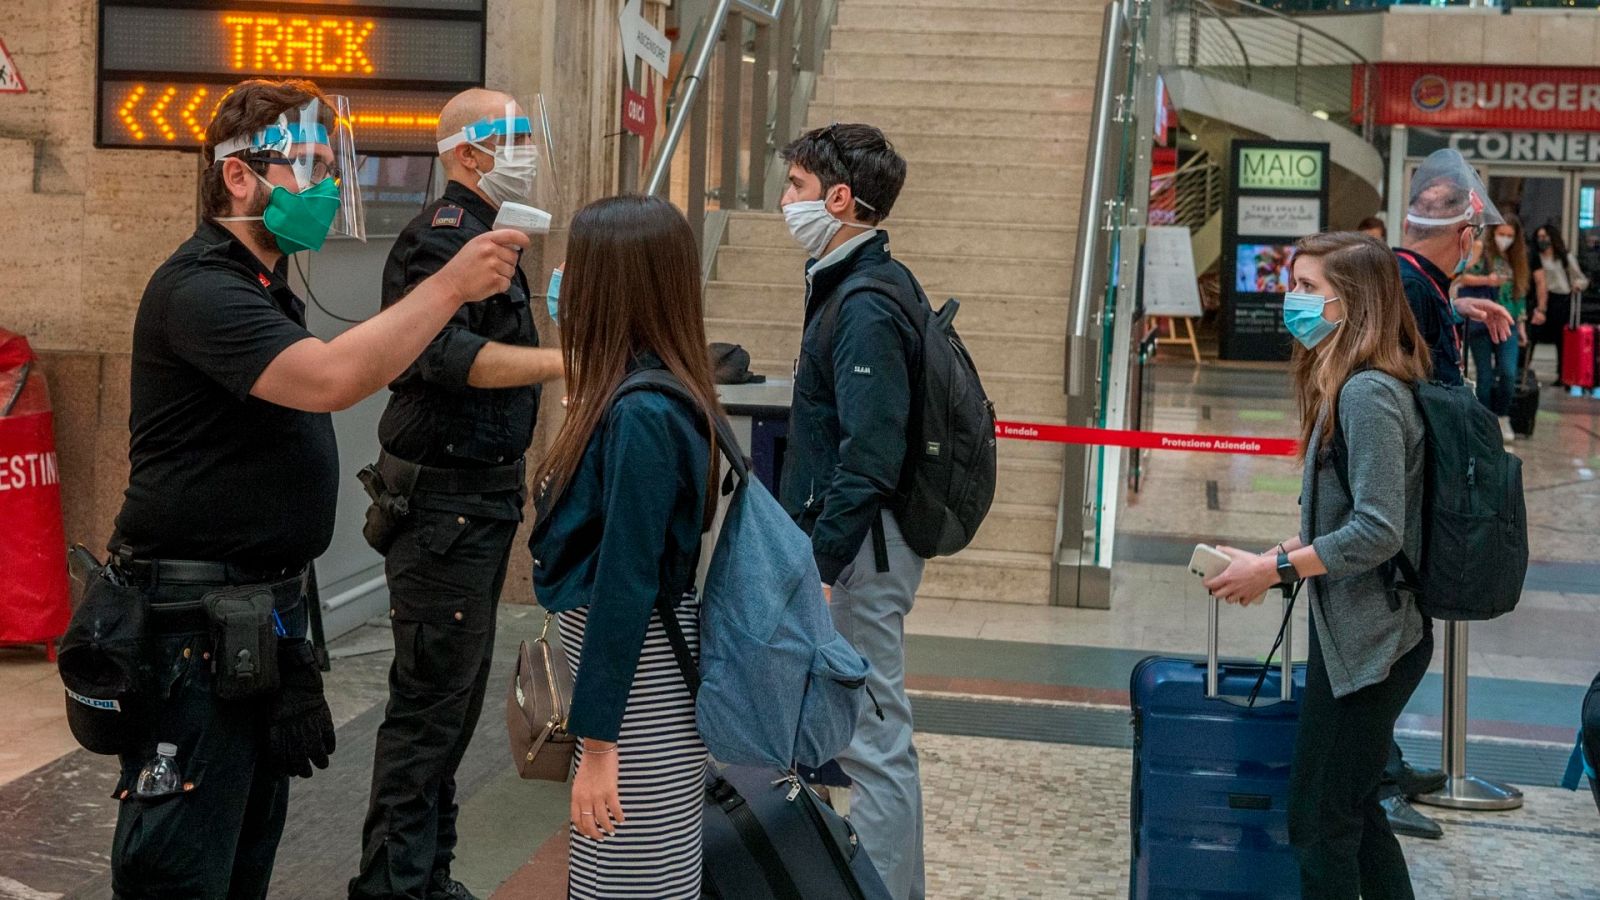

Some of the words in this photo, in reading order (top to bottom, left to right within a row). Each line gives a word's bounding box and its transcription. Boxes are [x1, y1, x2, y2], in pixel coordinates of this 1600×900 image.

[225, 16, 375, 73] TRACK
[1452, 80, 1600, 112] BURGER
[1244, 153, 1317, 177] MAIO
[1161, 437, 1212, 449] Protezione
[1213, 440, 1261, 452] Aziendale
